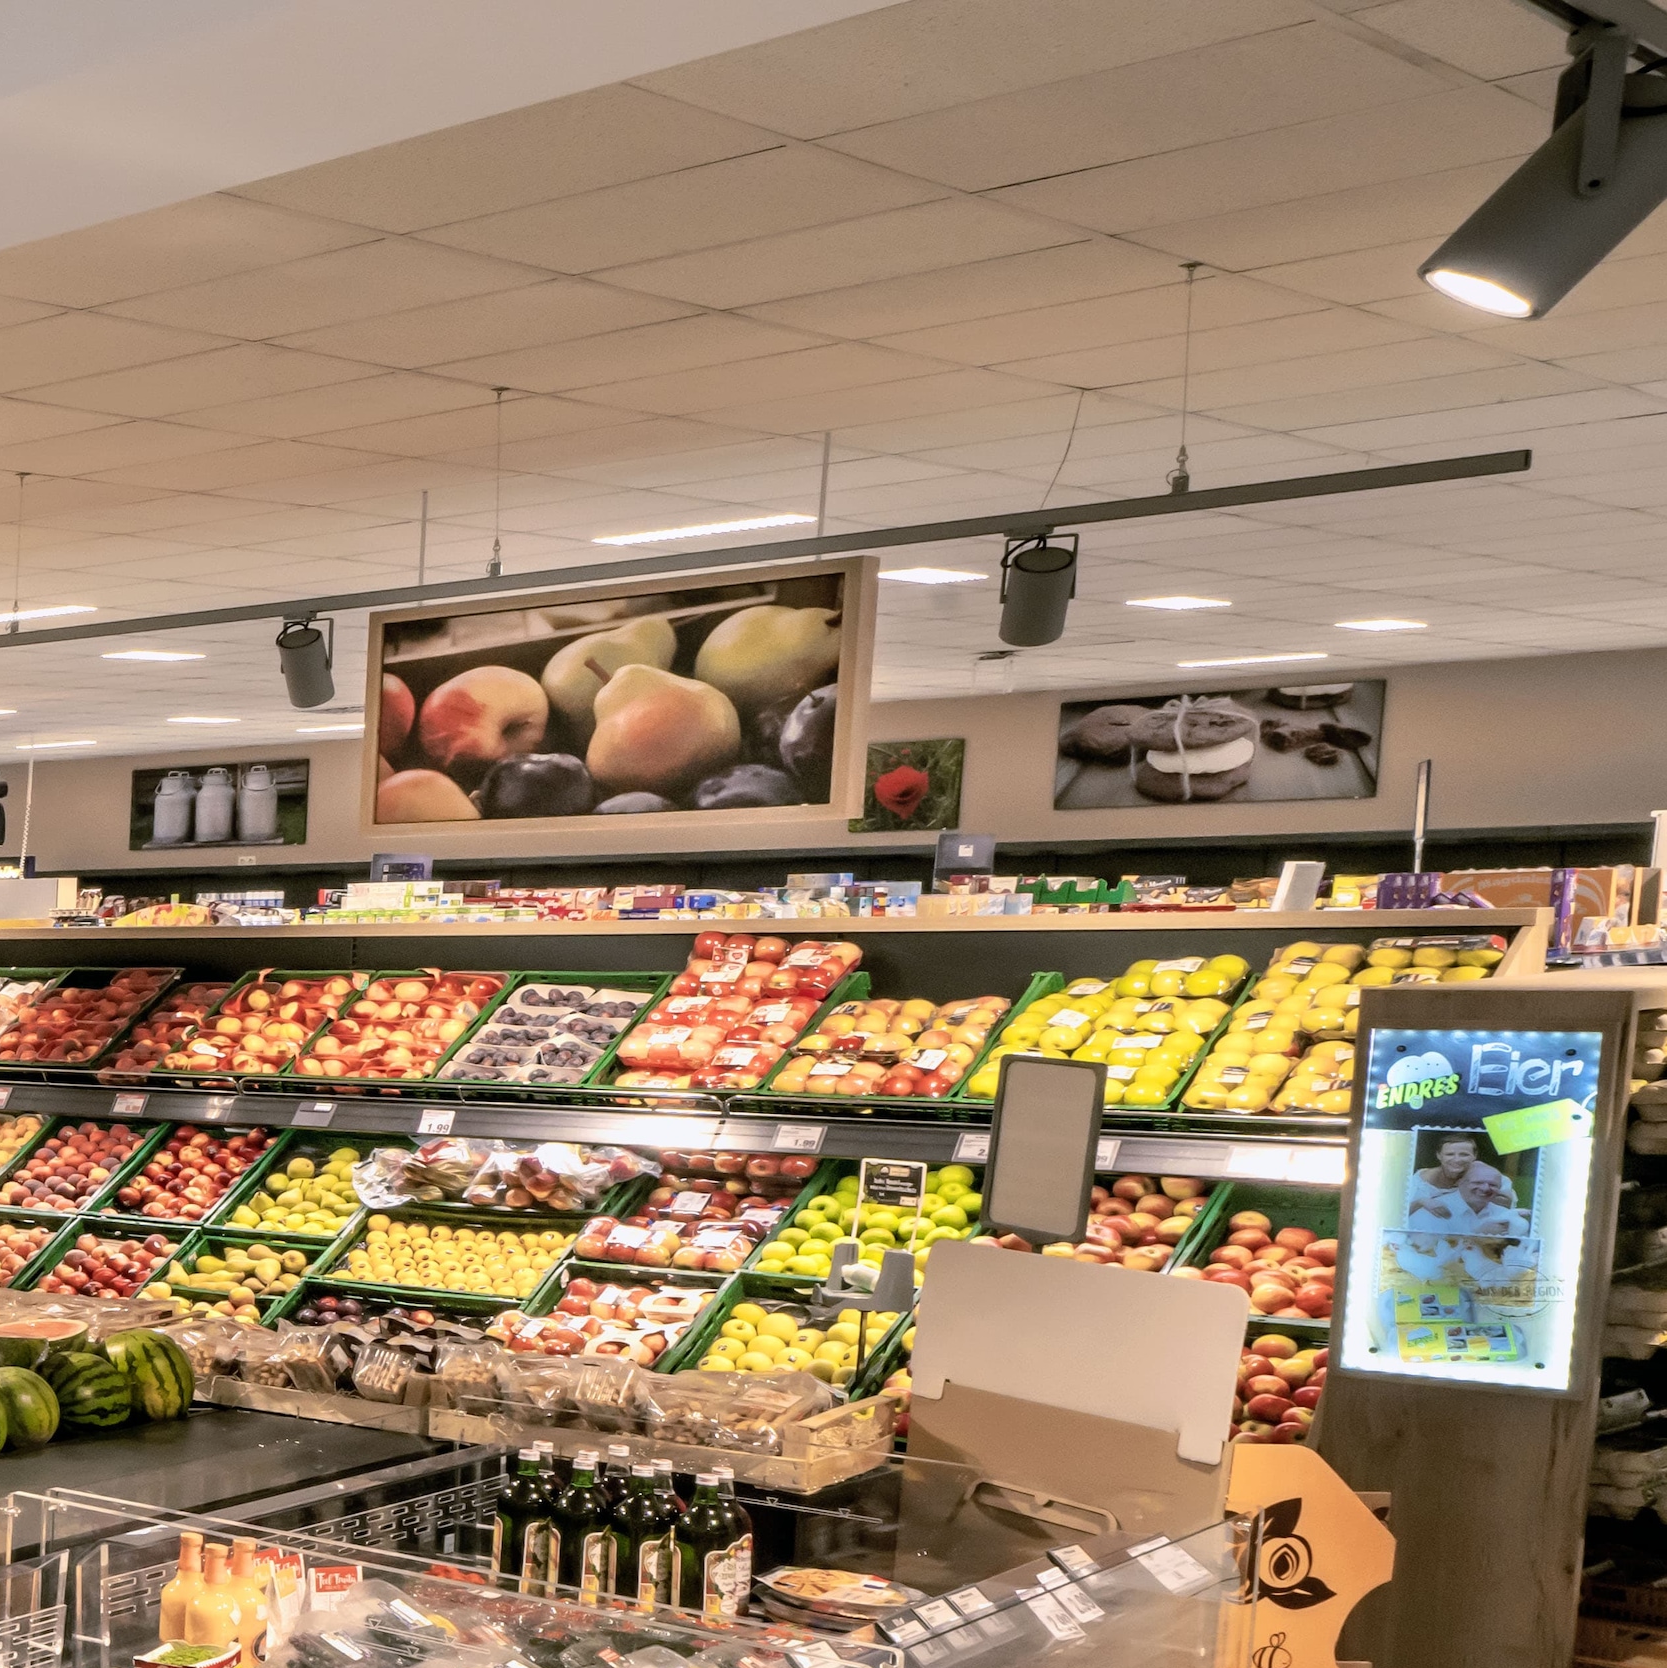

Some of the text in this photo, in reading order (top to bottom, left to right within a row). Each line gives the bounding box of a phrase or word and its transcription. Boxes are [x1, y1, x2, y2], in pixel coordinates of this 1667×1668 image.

[1468, 1042, 1584, 1097] Eier
[1375, 1073, 1460, 1110] ENDRES
[427, 1123, 450, 1133] 1.99
[1525, 1285, 1565, 1298] REGION
